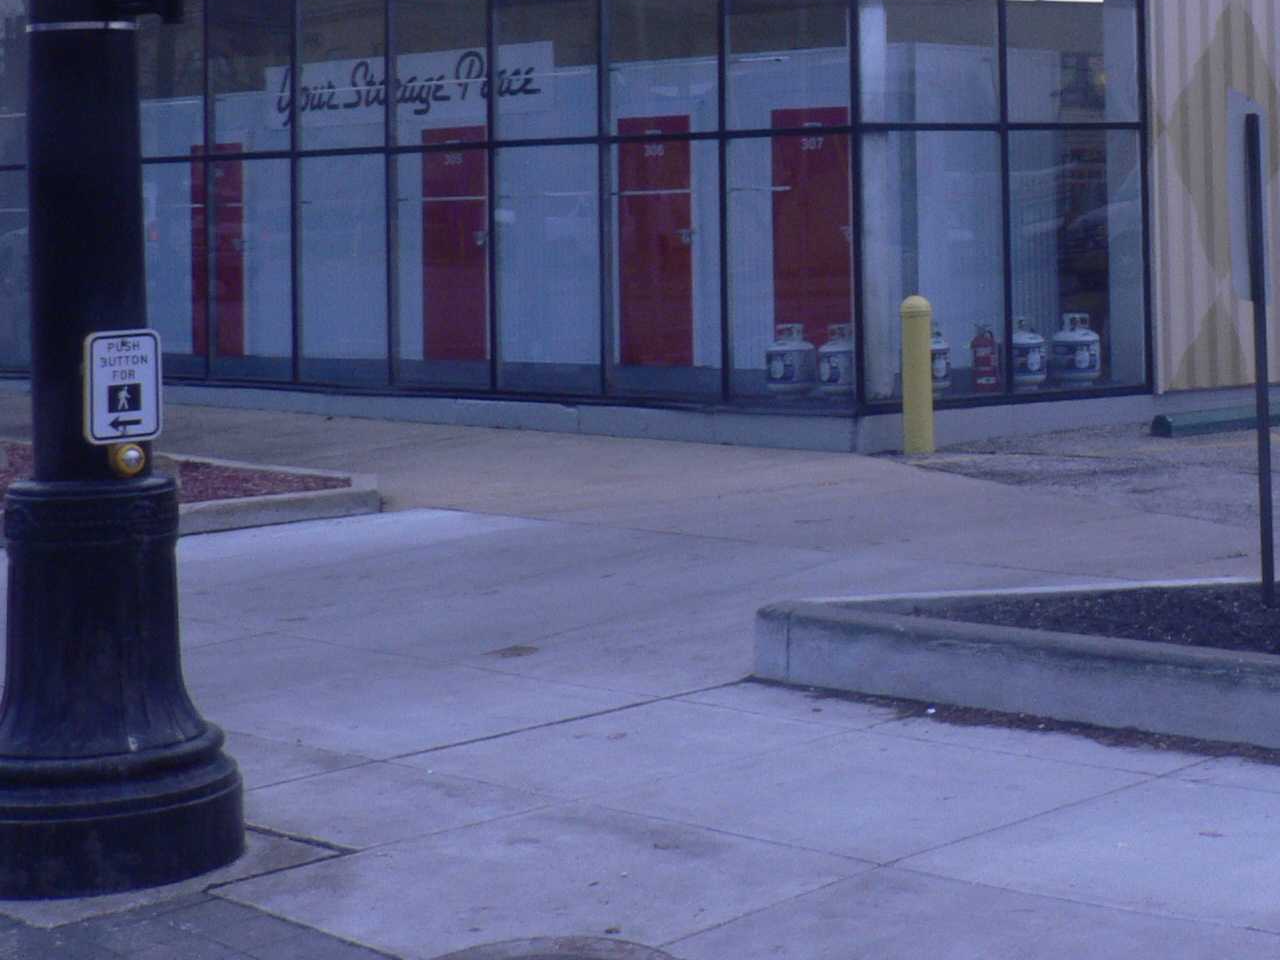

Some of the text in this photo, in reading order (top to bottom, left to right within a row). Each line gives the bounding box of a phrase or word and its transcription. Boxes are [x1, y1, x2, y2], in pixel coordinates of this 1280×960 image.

[455, 50, 541, 101] Pace
[107, 341, 141, 353] PUSH
[100, 354, 148, 368] BUTTON
[112, 369, 135, 381] FOR
